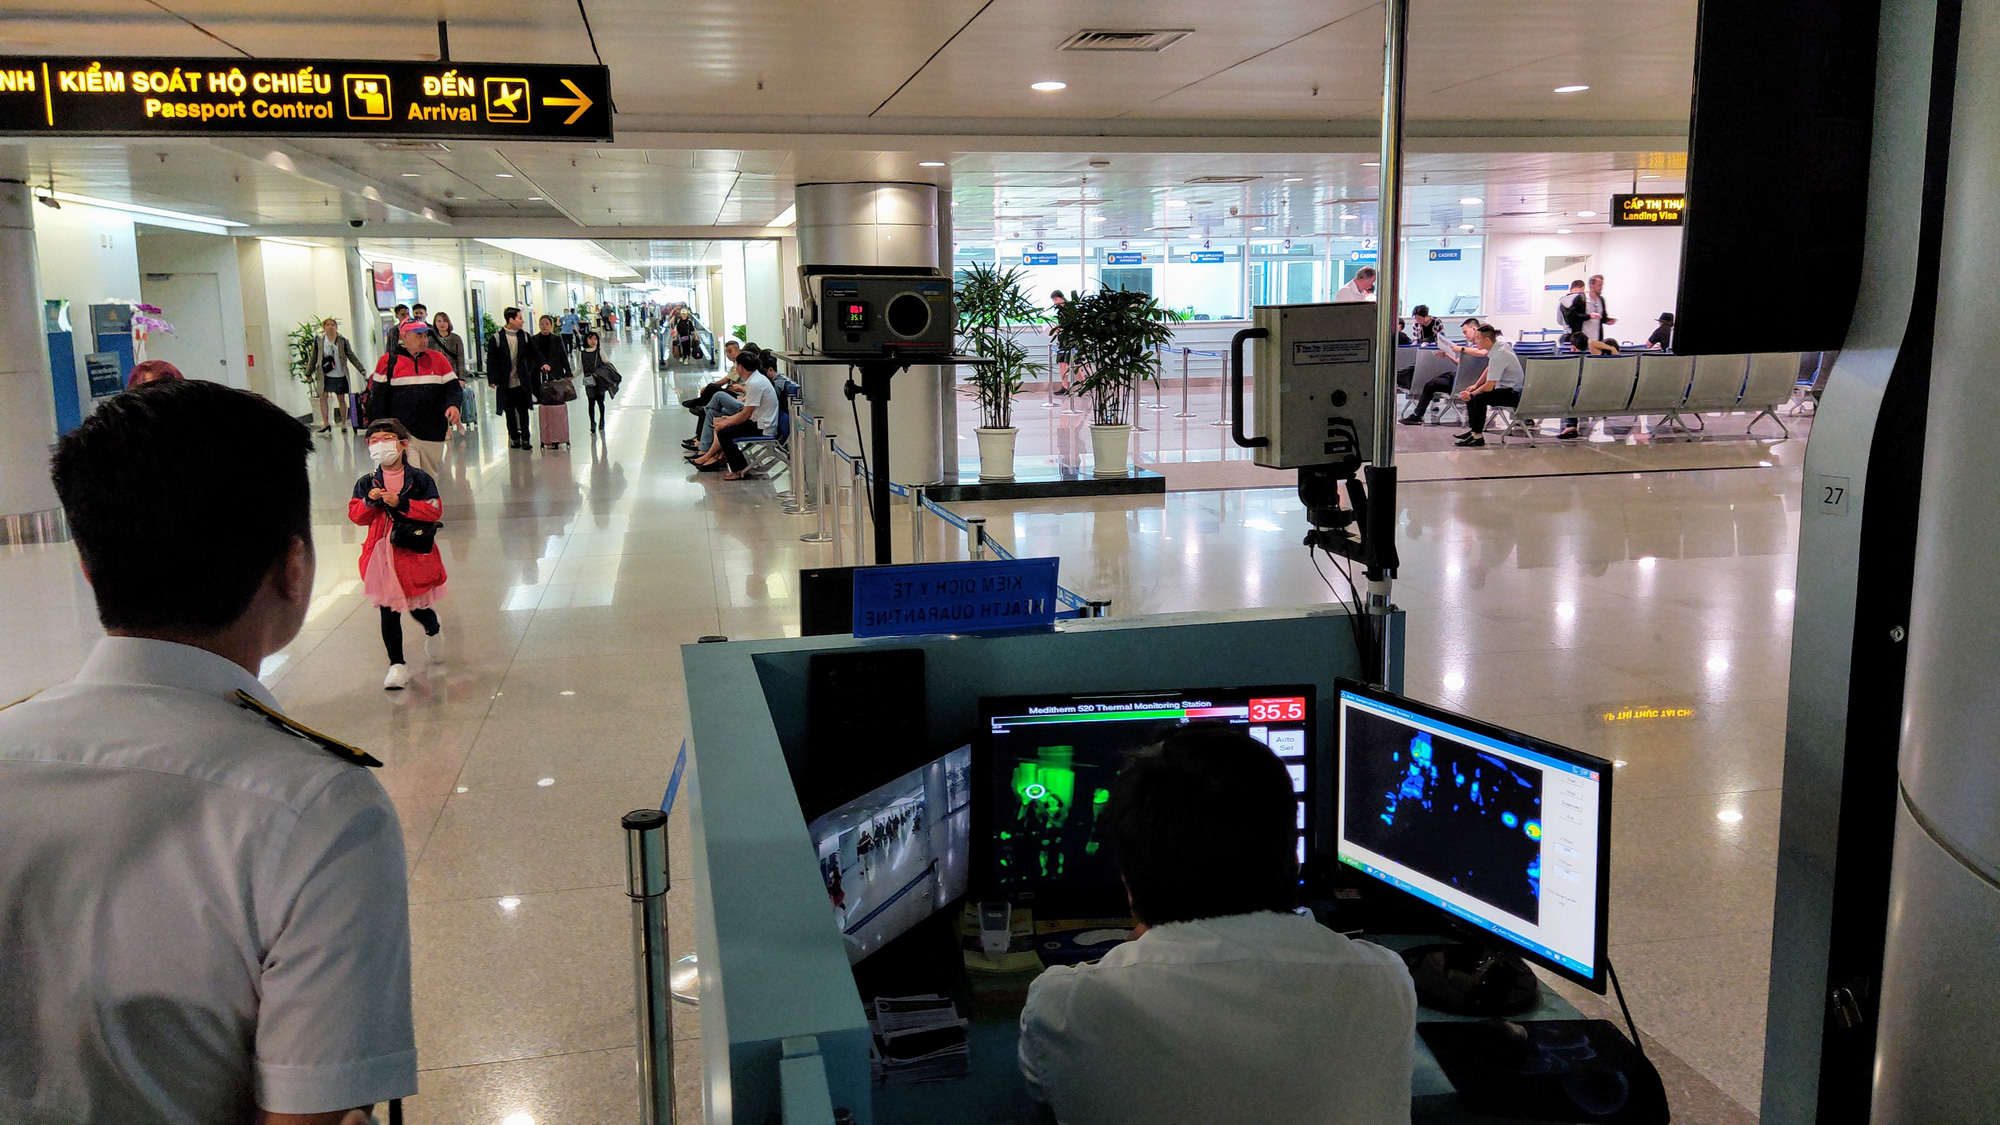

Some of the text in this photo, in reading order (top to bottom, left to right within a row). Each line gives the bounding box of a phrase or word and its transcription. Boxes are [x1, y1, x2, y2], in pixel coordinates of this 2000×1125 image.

[59, 61, 332, 97] KIỂM SOÁT HỘ CHIẾU
[423, 69, 476, 97] ĐẾN
[145, 98, 334, 122] Passport Control
[407, 102, 477, 122] Arrival
[1663, 198, 1685, 211] THỰ
[1623, 211, 1678, 222] Landing Visa
[1036, 241, 1044, 252] 6
[1121, 240, 1128, 251] 5
[1203, 239, 1210, 250] 4
[1284, 239, 1291, 249] 3
[1364, 238, 1371, 249] 2
[1824, 486, 1844, 505] 27
[1028, 700, 1212, 715] Meditherm 520 Thermal Monitoring Station
[1252, 703, 1302, 720] 35.5
